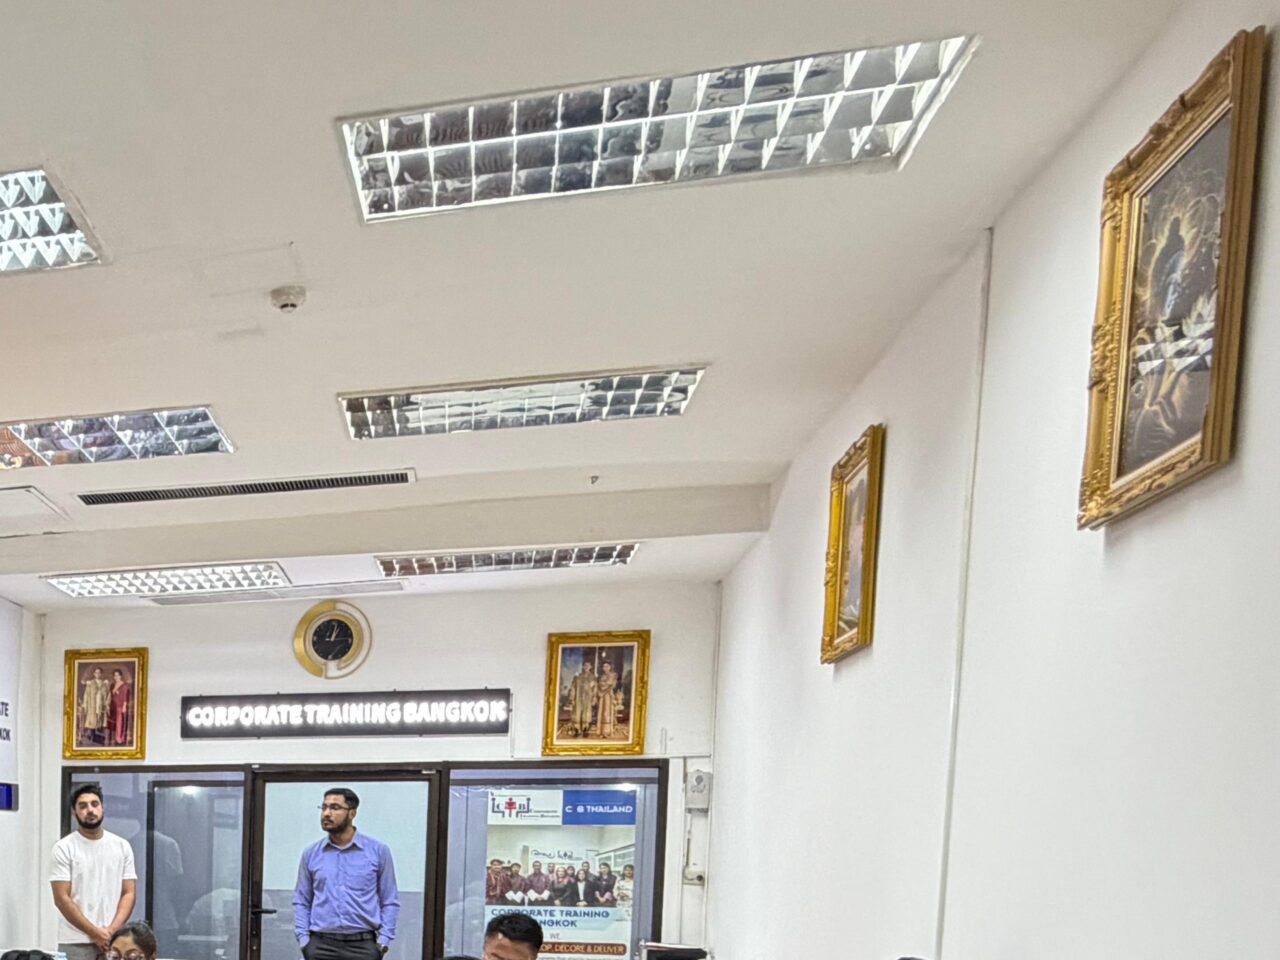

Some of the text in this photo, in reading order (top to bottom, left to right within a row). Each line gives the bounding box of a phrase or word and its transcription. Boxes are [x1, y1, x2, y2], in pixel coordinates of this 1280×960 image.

[187, 699, 507, 728] CORPORATE TRAINING BANGKOK
[586, 805, 633, 813] THAILAND
[560, 909, 611, 918] TRAINING
[540, 919, 578, 927] NGKOK
